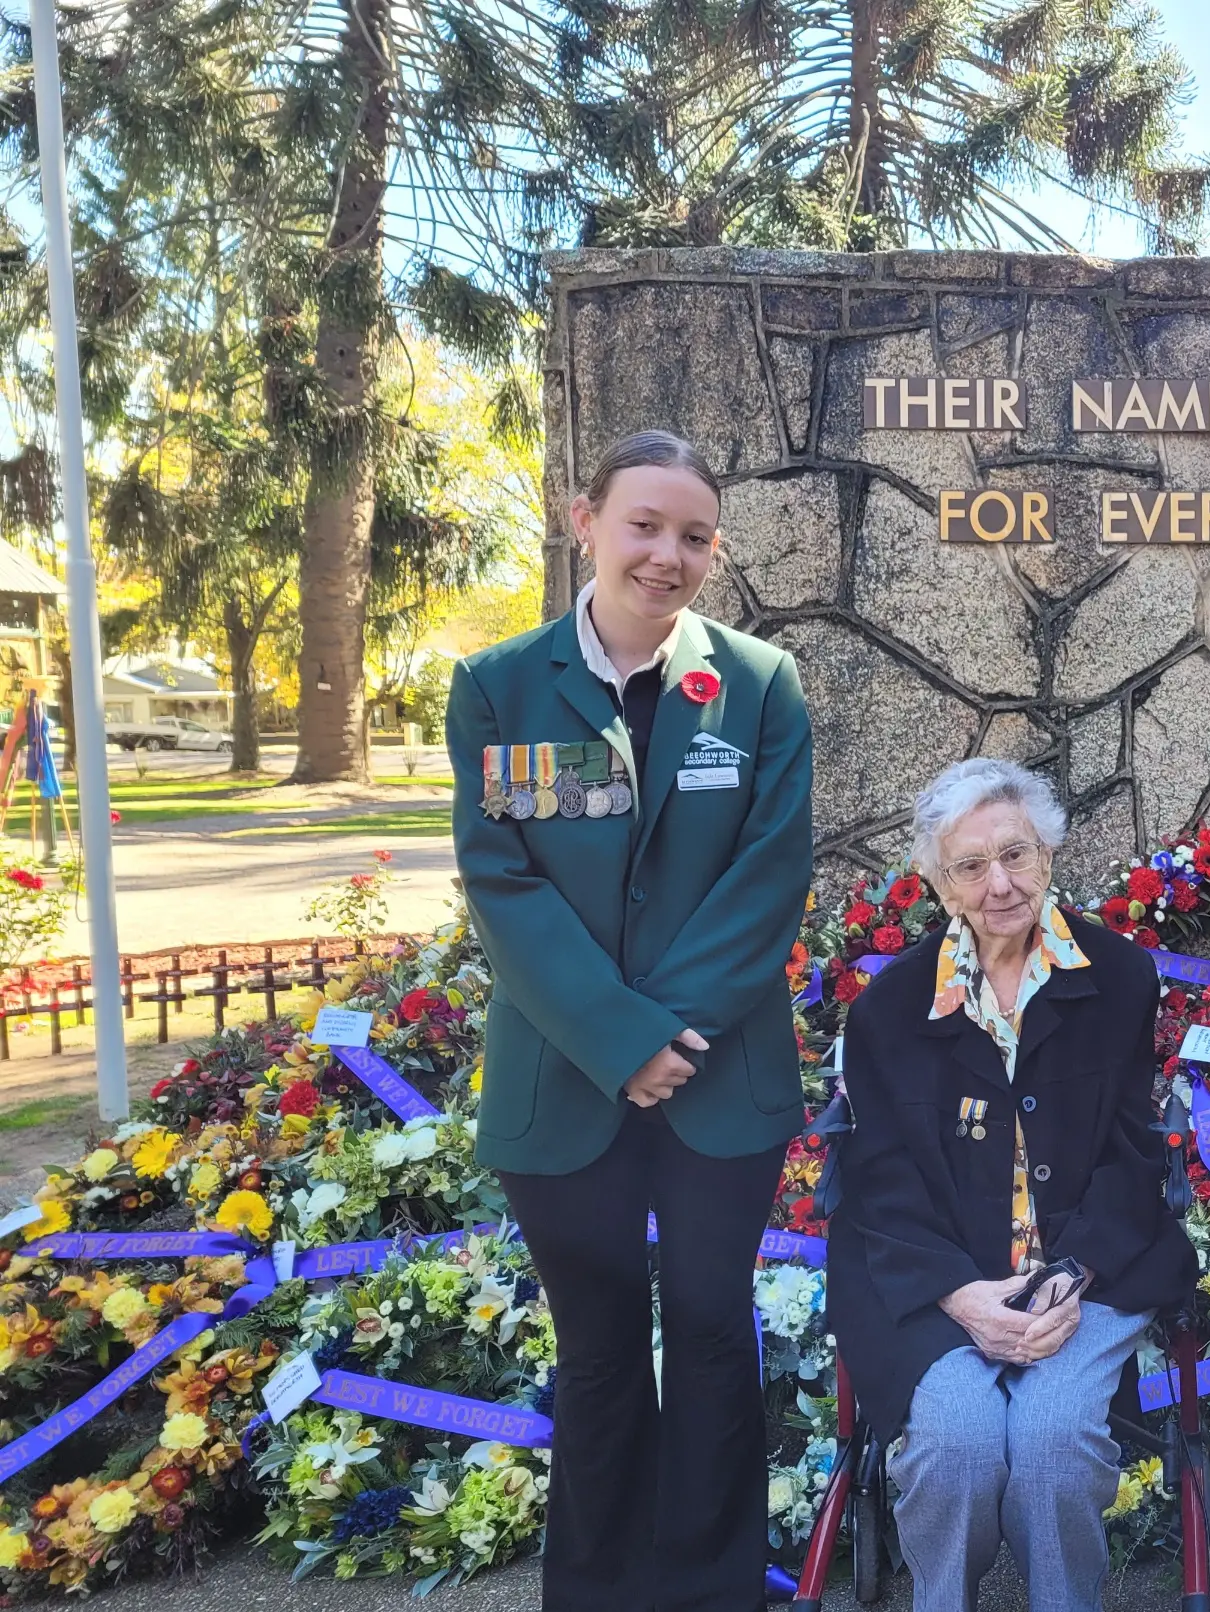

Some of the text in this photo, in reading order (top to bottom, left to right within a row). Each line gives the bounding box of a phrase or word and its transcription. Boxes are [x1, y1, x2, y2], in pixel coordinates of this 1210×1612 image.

[865, 378, 1022, 429] THEIR
[939, 491, 1053, 541] FOR
[684, 751, 740, 760] BEECHWORTH
[684, 758, 717, 766] secondary
[1155, 955, 1175, 972] ST
[1179, 959, 1209, 980] WE
[340, 1046, 409, 1103] LEST WE
[118, 1234, 203, 1253] FORGET
[760, 1234, 806, 1255] GET
[316, 1247, 376, 1272] LEST
[0, 1329, 179, 1474] ST WE FORGET
[322, 1374, 534, 1440] LEST WE FORGET
